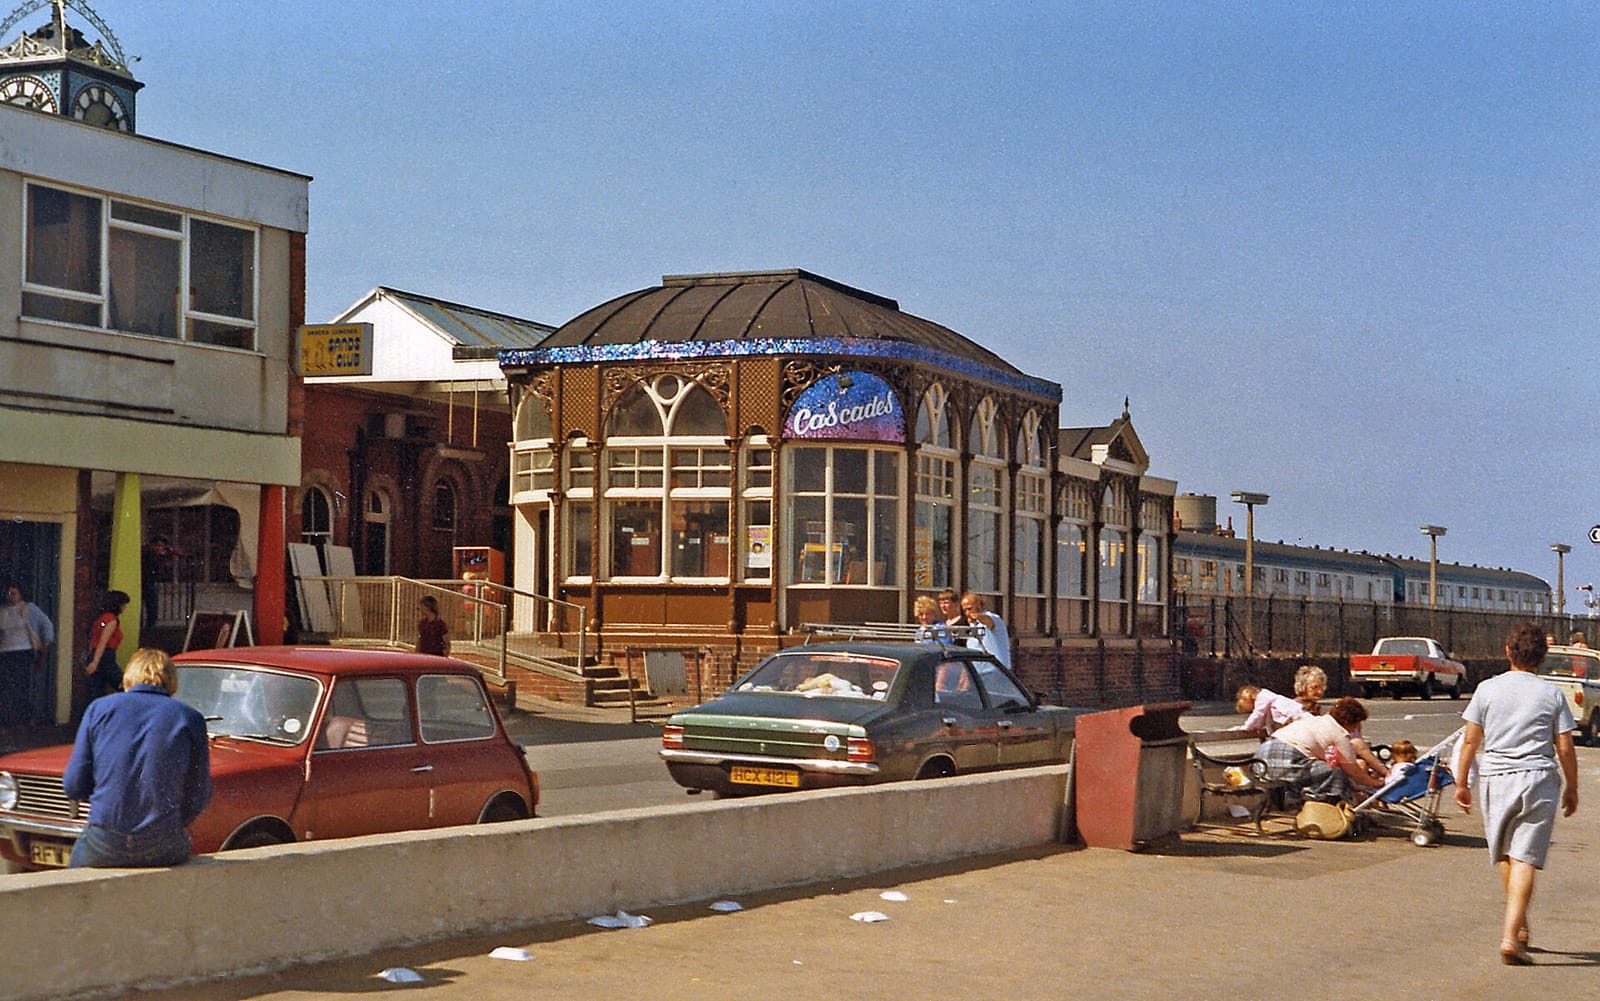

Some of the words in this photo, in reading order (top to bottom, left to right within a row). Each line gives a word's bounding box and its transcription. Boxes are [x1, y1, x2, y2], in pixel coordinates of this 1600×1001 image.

[336, 352, 360, 368] CLUB
[733, 767, 761, 782] HCX
[765, 769, 793, 785] 412L
